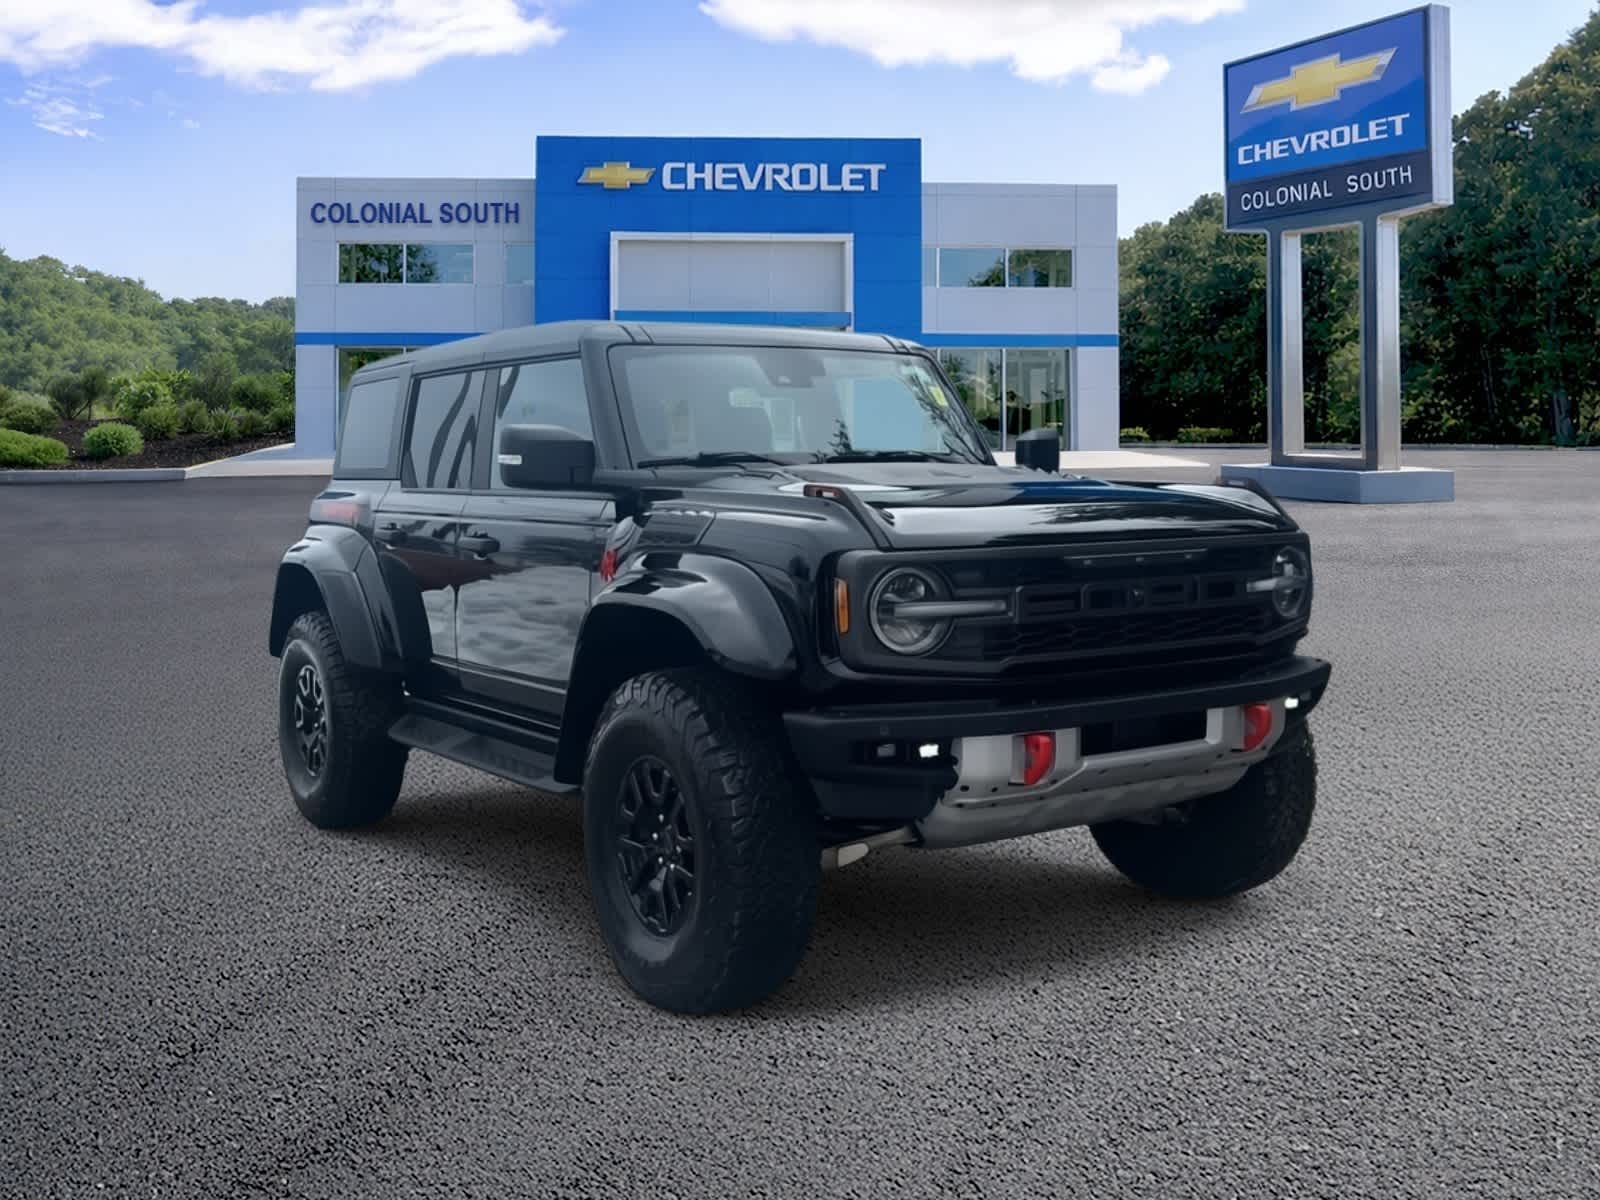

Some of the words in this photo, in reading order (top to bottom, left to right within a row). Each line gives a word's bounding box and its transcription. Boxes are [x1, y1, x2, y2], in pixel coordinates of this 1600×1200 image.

[1237, 113, 1411, 165] CHEVROLET
[662, 162, 887, 192] CHEVROLET
[1240, 180, 1333, 211] COLONIAL
[1346, 165, 1412, 193] SOUTH
[310, 202, 433, 225] COLONIAL
[439, 202, 520, 225] SOUTH
